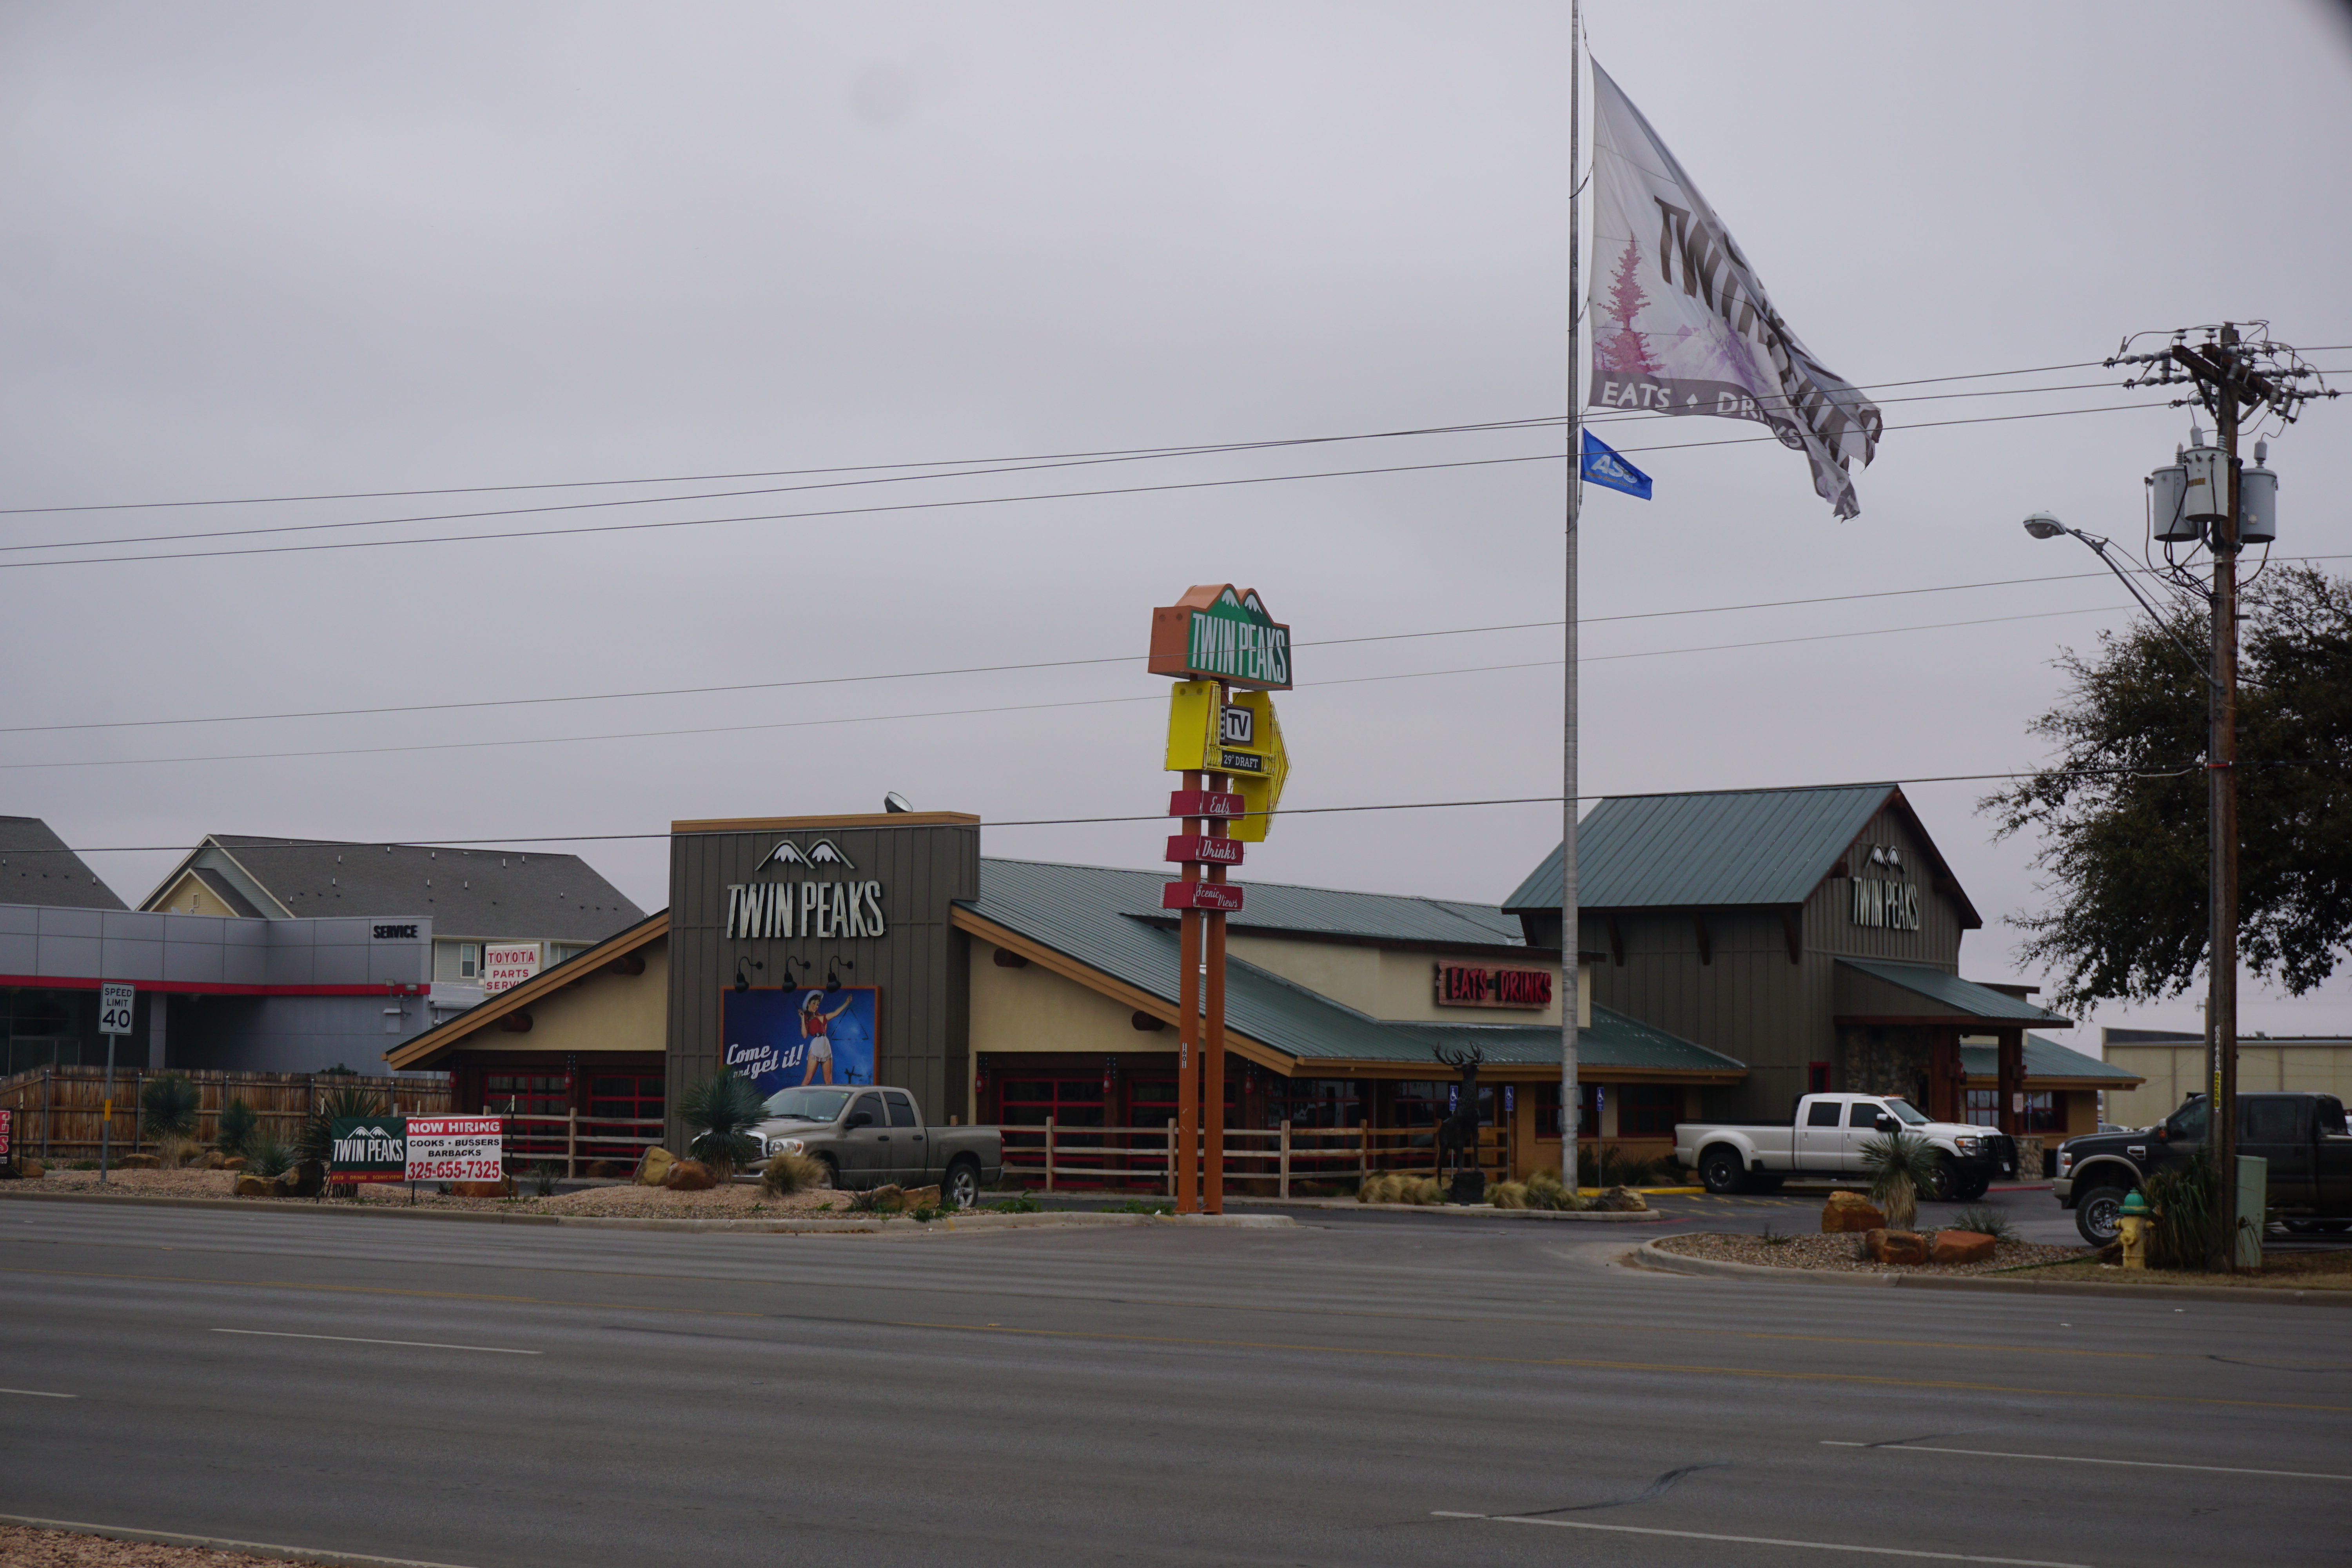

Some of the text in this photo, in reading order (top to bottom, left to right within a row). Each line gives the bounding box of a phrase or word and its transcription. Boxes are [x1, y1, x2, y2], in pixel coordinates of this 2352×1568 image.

[1601, 381, 1802, 448] EATS DRIKS
[1192, 613, 1287, 684] TWIN PEAKS
[1228, 713, 1248, 737] TV
[1235, 756, 1258, 768] DRAFT
[1210, 795, 1231, 814] Eats
[1201, 839, 1236, 860] Drinks
[1196, 884, 1220, 898] Scenic
[1217, 894, 1238, 907] Views
[726, 880, 884, 938] TWIN PEAKS
[1853, 877, 1919, 931] TWIN PEAKS
[374, 925, 418, 938] SERVICE
[488, 951, 534, 964] TOYOTA
[493, 969, 529, 978] PARTS
[105, 987, 132, 997] SPEED
[1450, 967, 1552, 1003] EATS DRINKS
[107, 998, 128, 1007] LIMIT
[102, 1009, 130, 1028] 40
[726, 1044, 771, 1065] Come
[751, 1050, 779, 1080] get
[782, 1044, 804, 1069] it!
[409, 1121, 500, 1133] NOW HIRING
[334, 1139, 404, 1162] TWIN PEAKS
[408, 1161, 499, 1180] 325-655-7325
